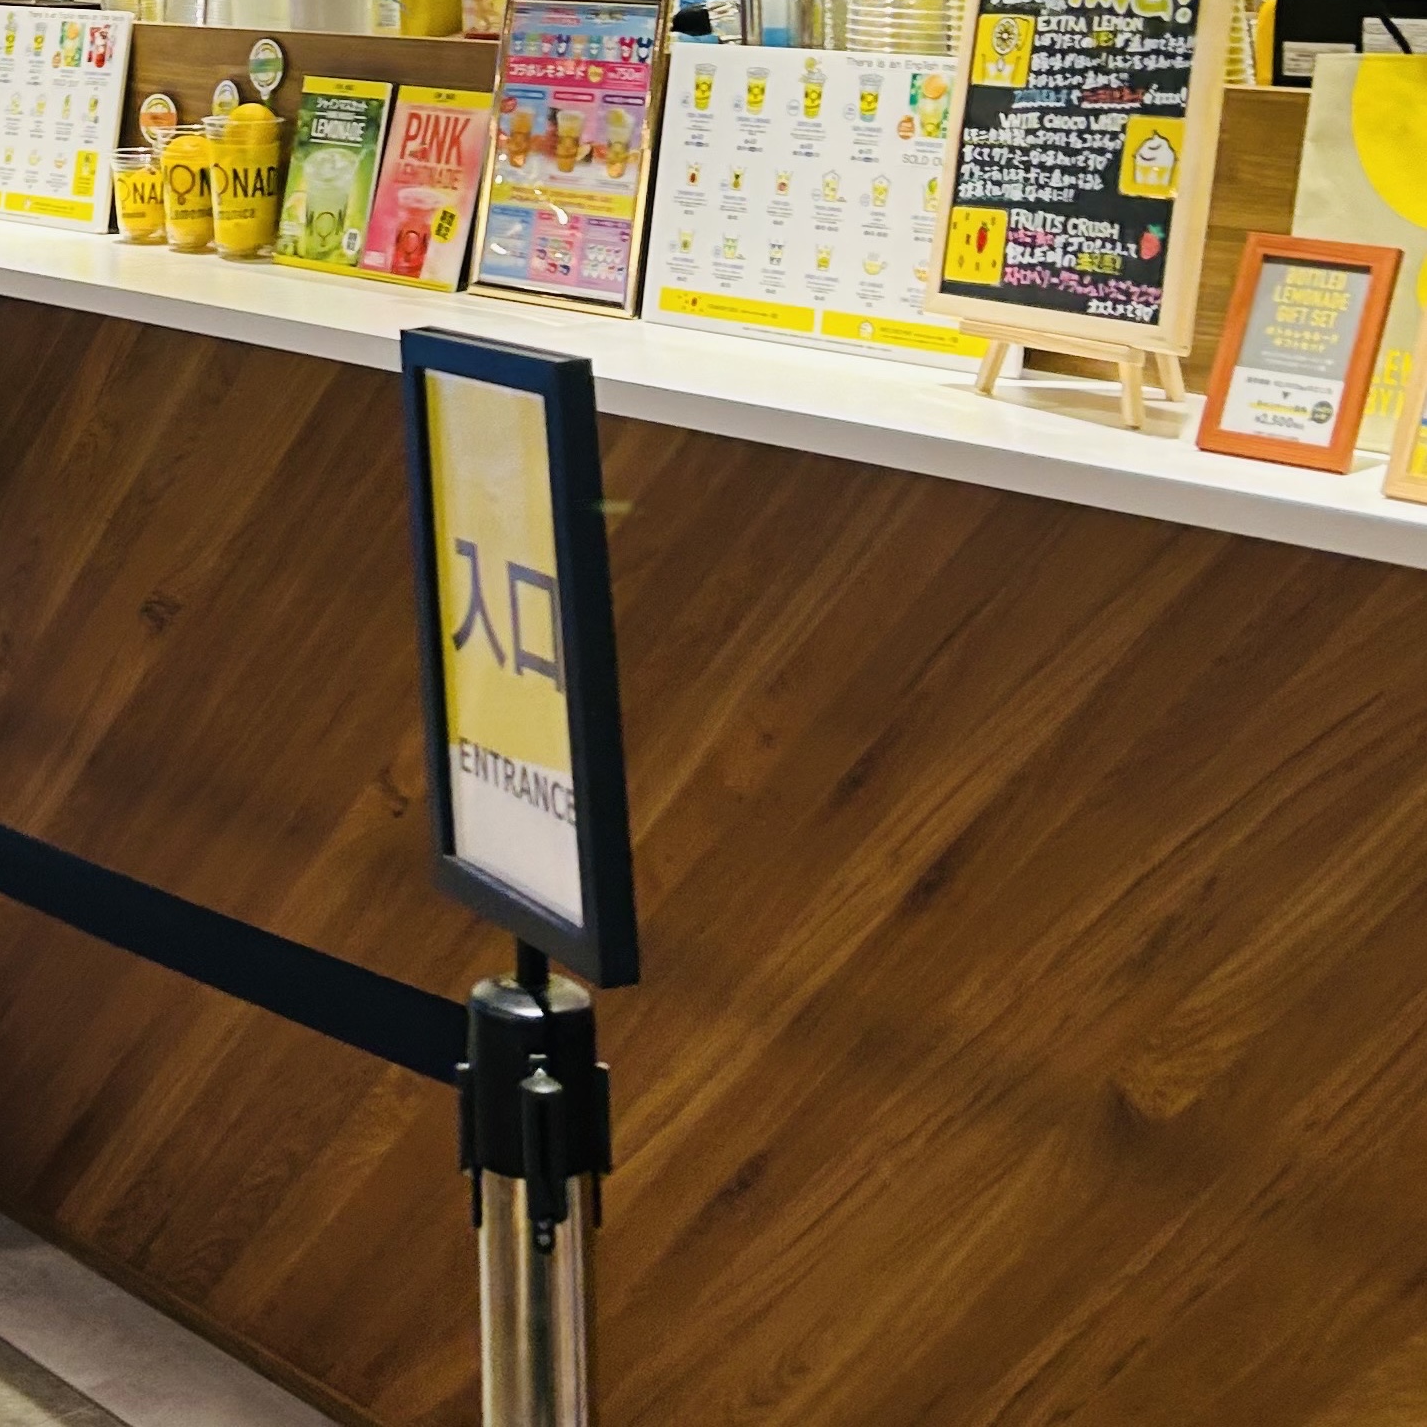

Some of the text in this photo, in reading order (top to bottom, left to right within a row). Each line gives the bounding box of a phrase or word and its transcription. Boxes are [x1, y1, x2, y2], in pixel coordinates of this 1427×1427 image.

[1036, 14, 1144, 33] EXTRA LEMON
[399, 111, 471, 167] PINK
[1010, 208, 1120, 240] FRUITS CRUSH
[451, 536, 566, 695] 入口
[459, 737, 578, 827] ENTRANCE
